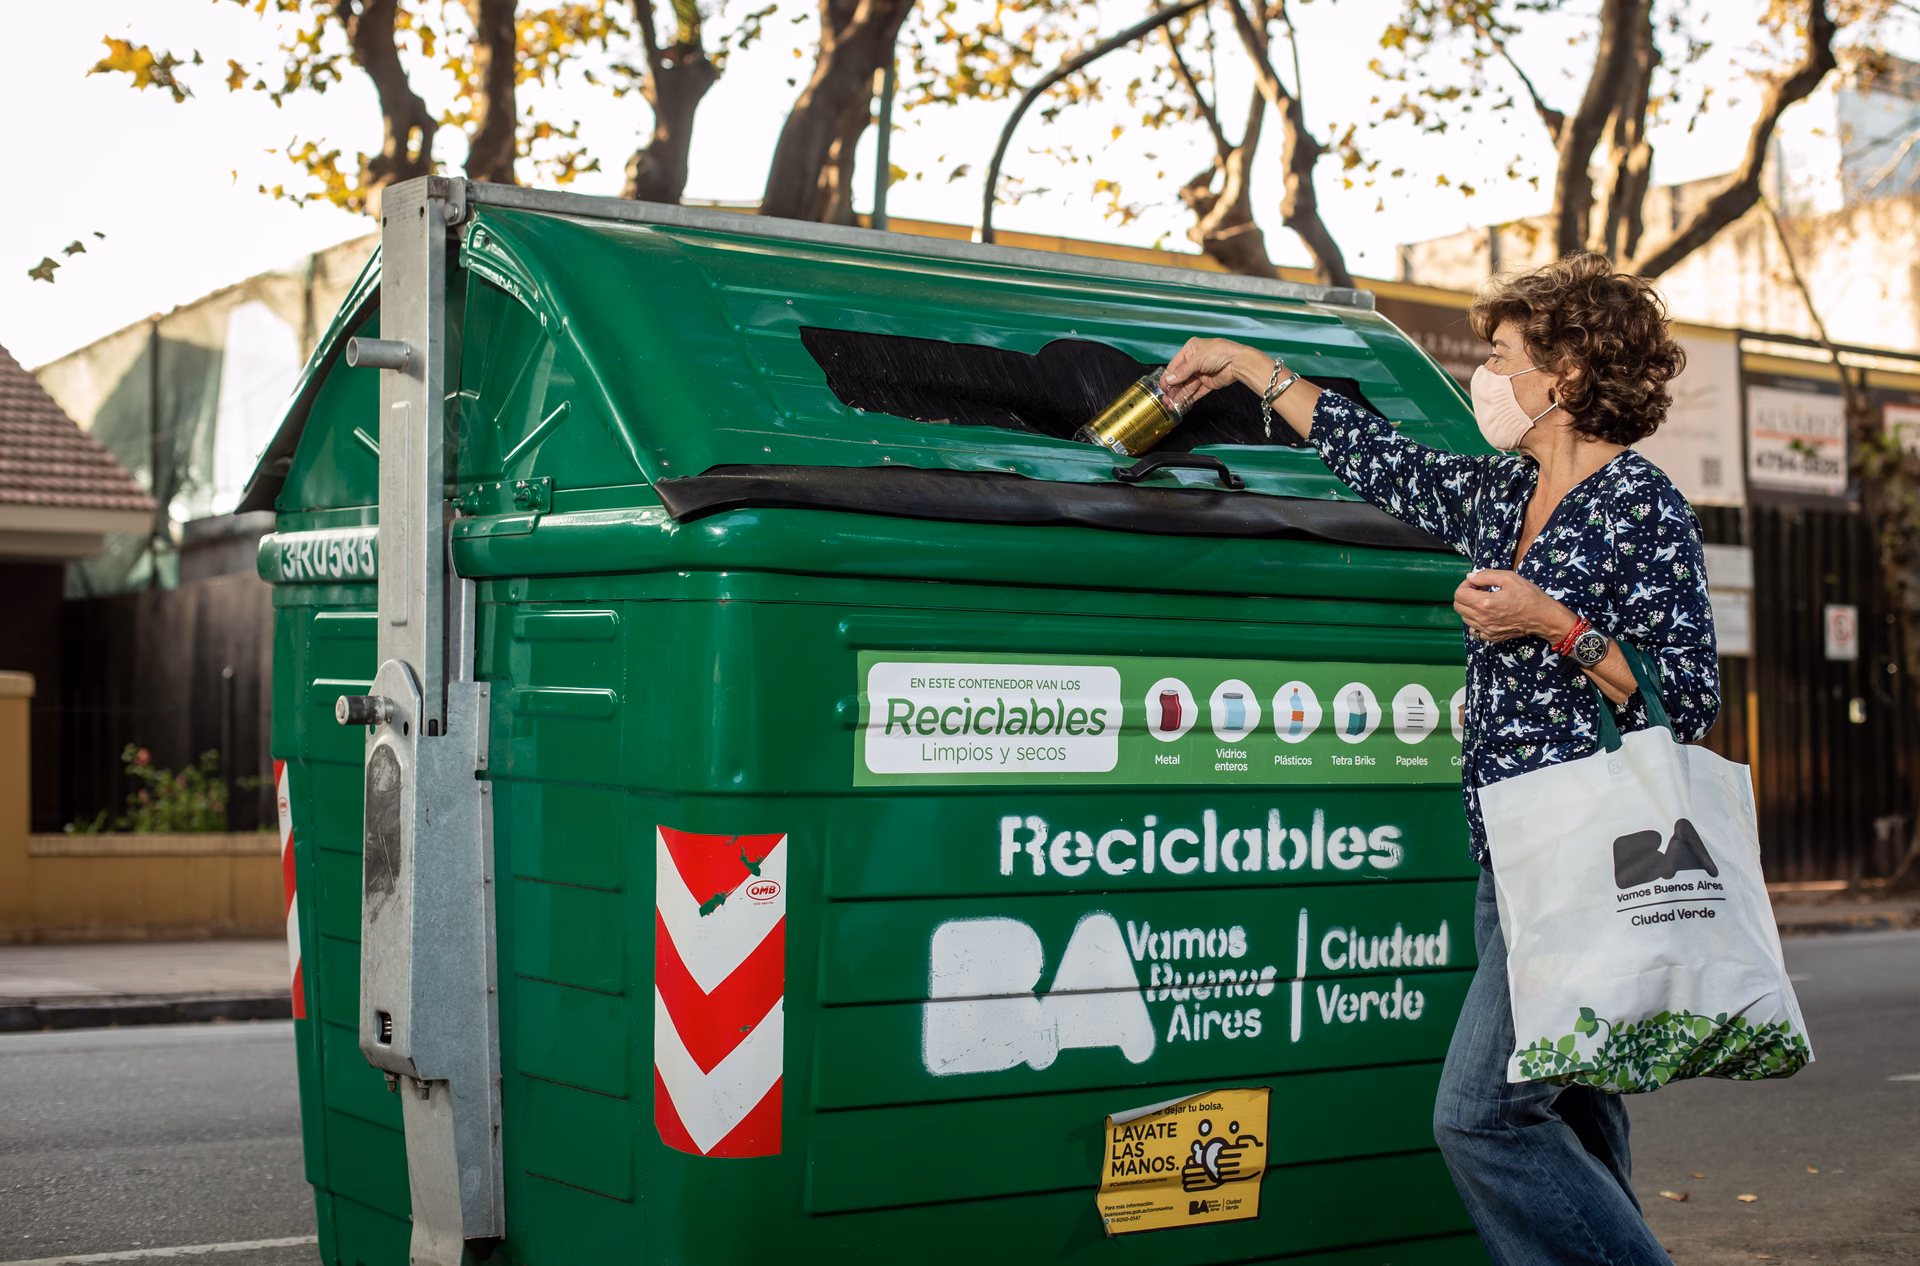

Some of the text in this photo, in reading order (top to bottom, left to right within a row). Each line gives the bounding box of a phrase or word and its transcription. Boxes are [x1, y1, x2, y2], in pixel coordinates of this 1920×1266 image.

[283, 538, 375, 578] 3R0585
[911, 678, 1081, 690] EN ESTE CONTENEDOR VAN LOS
[885, 697, 1107, 736] Reciclables
[922, 742, 1066, 764] Limpios y secos
[1155, 754, 1180, 765] Metal
[1215, 749, 1247, 759] Vidrios
[1274, 755, 1312, 766] Plásticos
[1331, 755, 1376, 766] Tetra Briks
[1396, 756, 1428, 768] Papeles
[1214, 761, 1248, 772] enteros
[999, 808, 1403, 877] Reciclables
[751, 886, 776, 895] OMB
[1616, 880, 1723, 903] Vamos Buenos Aires
[1631, 907, 1716, 926] Ciudad Verde
[1127, 919, 1247, 962] Vamos
[1320, 919, 1450, 971] Ciudad
[1147, 962, 1277, 1003] Buenos
[1317, 978, 1425, 1025] Verde
[1167, 1005, 1262, 1043] Aires
[1164, 1105, 1186, 1115] dejar
[1188, 1104, 1197, 1112] tu
[1199, 1102, 1224, 1111] bolsa,
[1113, 1122, 1178, 1143] LAVATE
[1112, 1141, 1145, 1160] LAS
[1111, 1155, 1180, 1177] MANOS.
